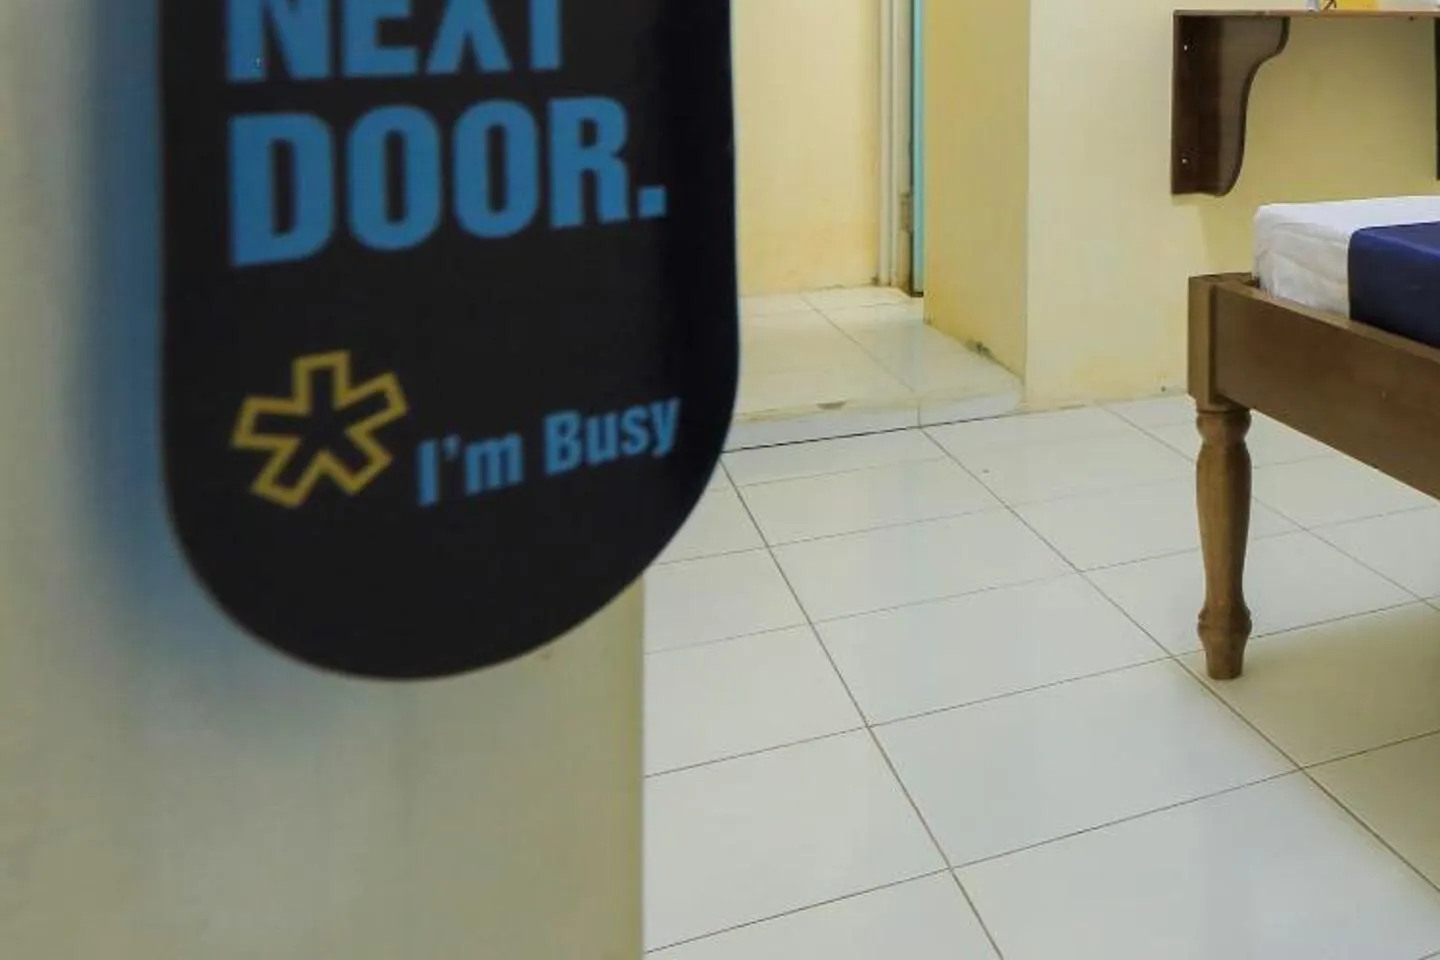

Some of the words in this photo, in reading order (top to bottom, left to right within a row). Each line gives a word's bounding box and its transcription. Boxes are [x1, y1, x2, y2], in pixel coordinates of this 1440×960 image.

[229, 96, 668, 267] DOOR.
[417, 434, 525, 507] I'm
[544, 398, 682, 476] Busy
